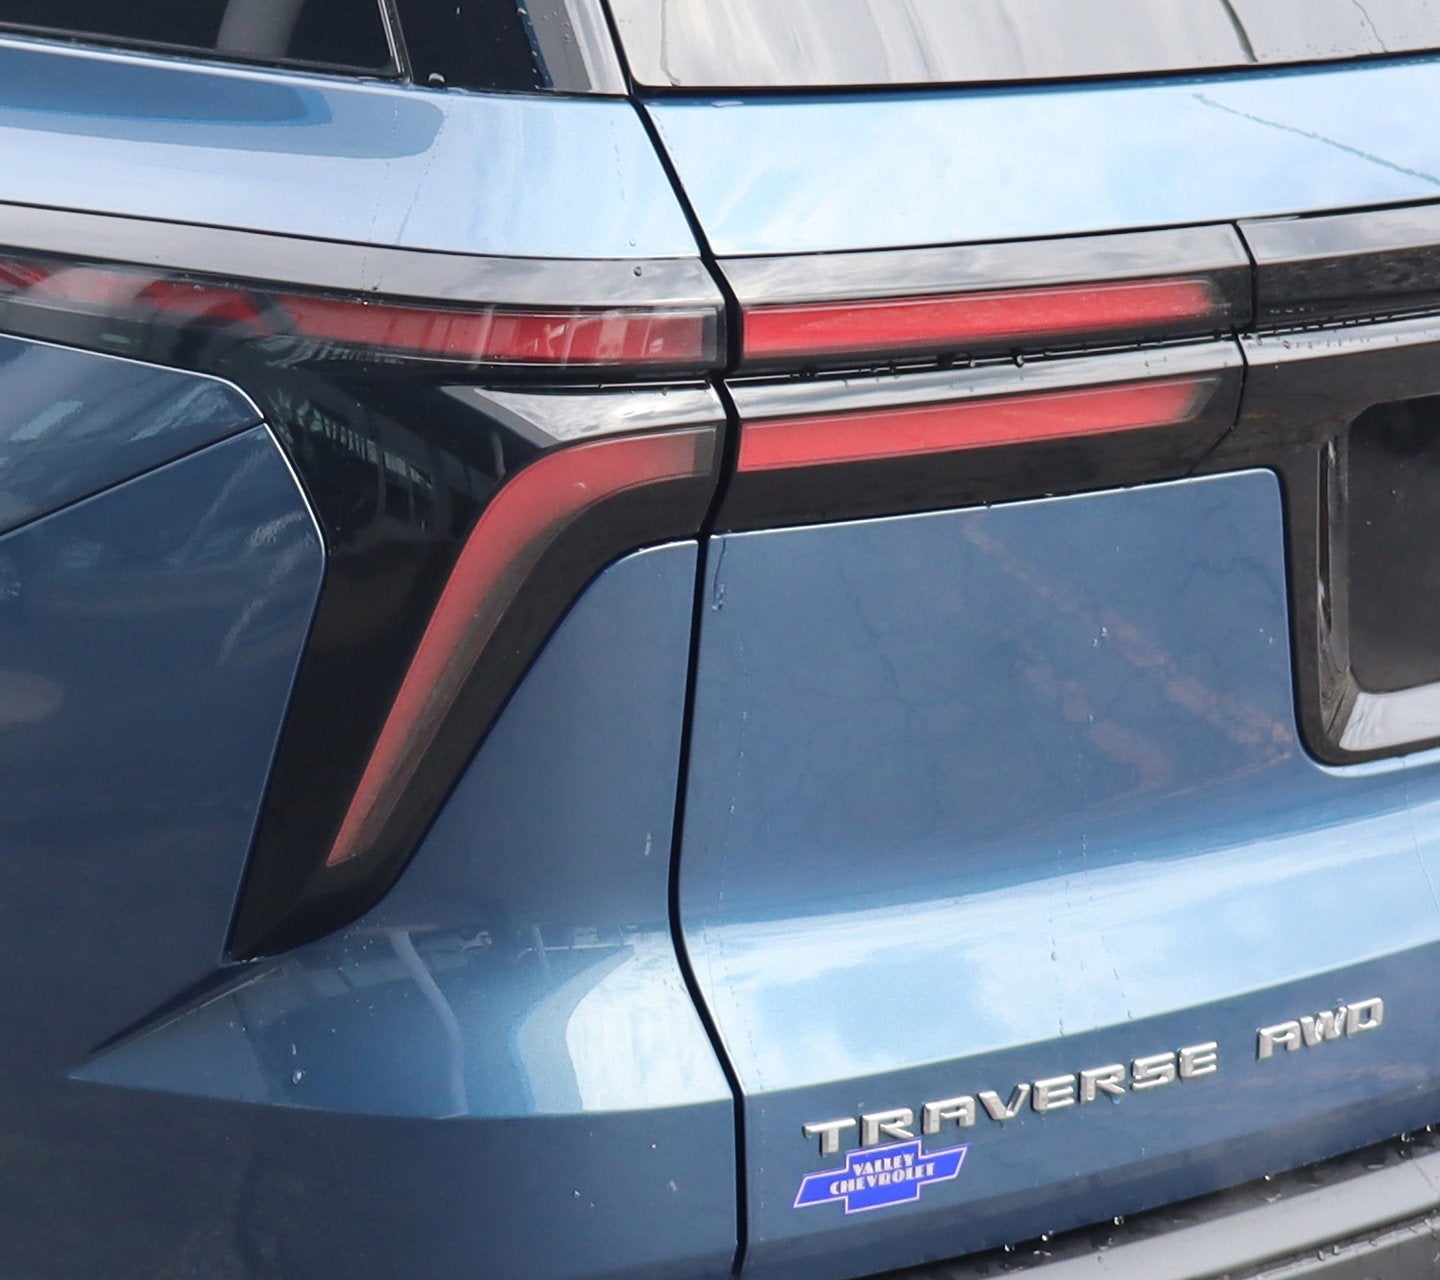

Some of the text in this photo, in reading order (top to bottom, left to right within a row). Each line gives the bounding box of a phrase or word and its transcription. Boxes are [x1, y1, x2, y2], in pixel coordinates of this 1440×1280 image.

[803, 996, 1385, 1157] TRAVERSE AWD
[829, 1162, 936, 1195] CHEVROLET
[852, 1152, 915, 1176] VALLEY
